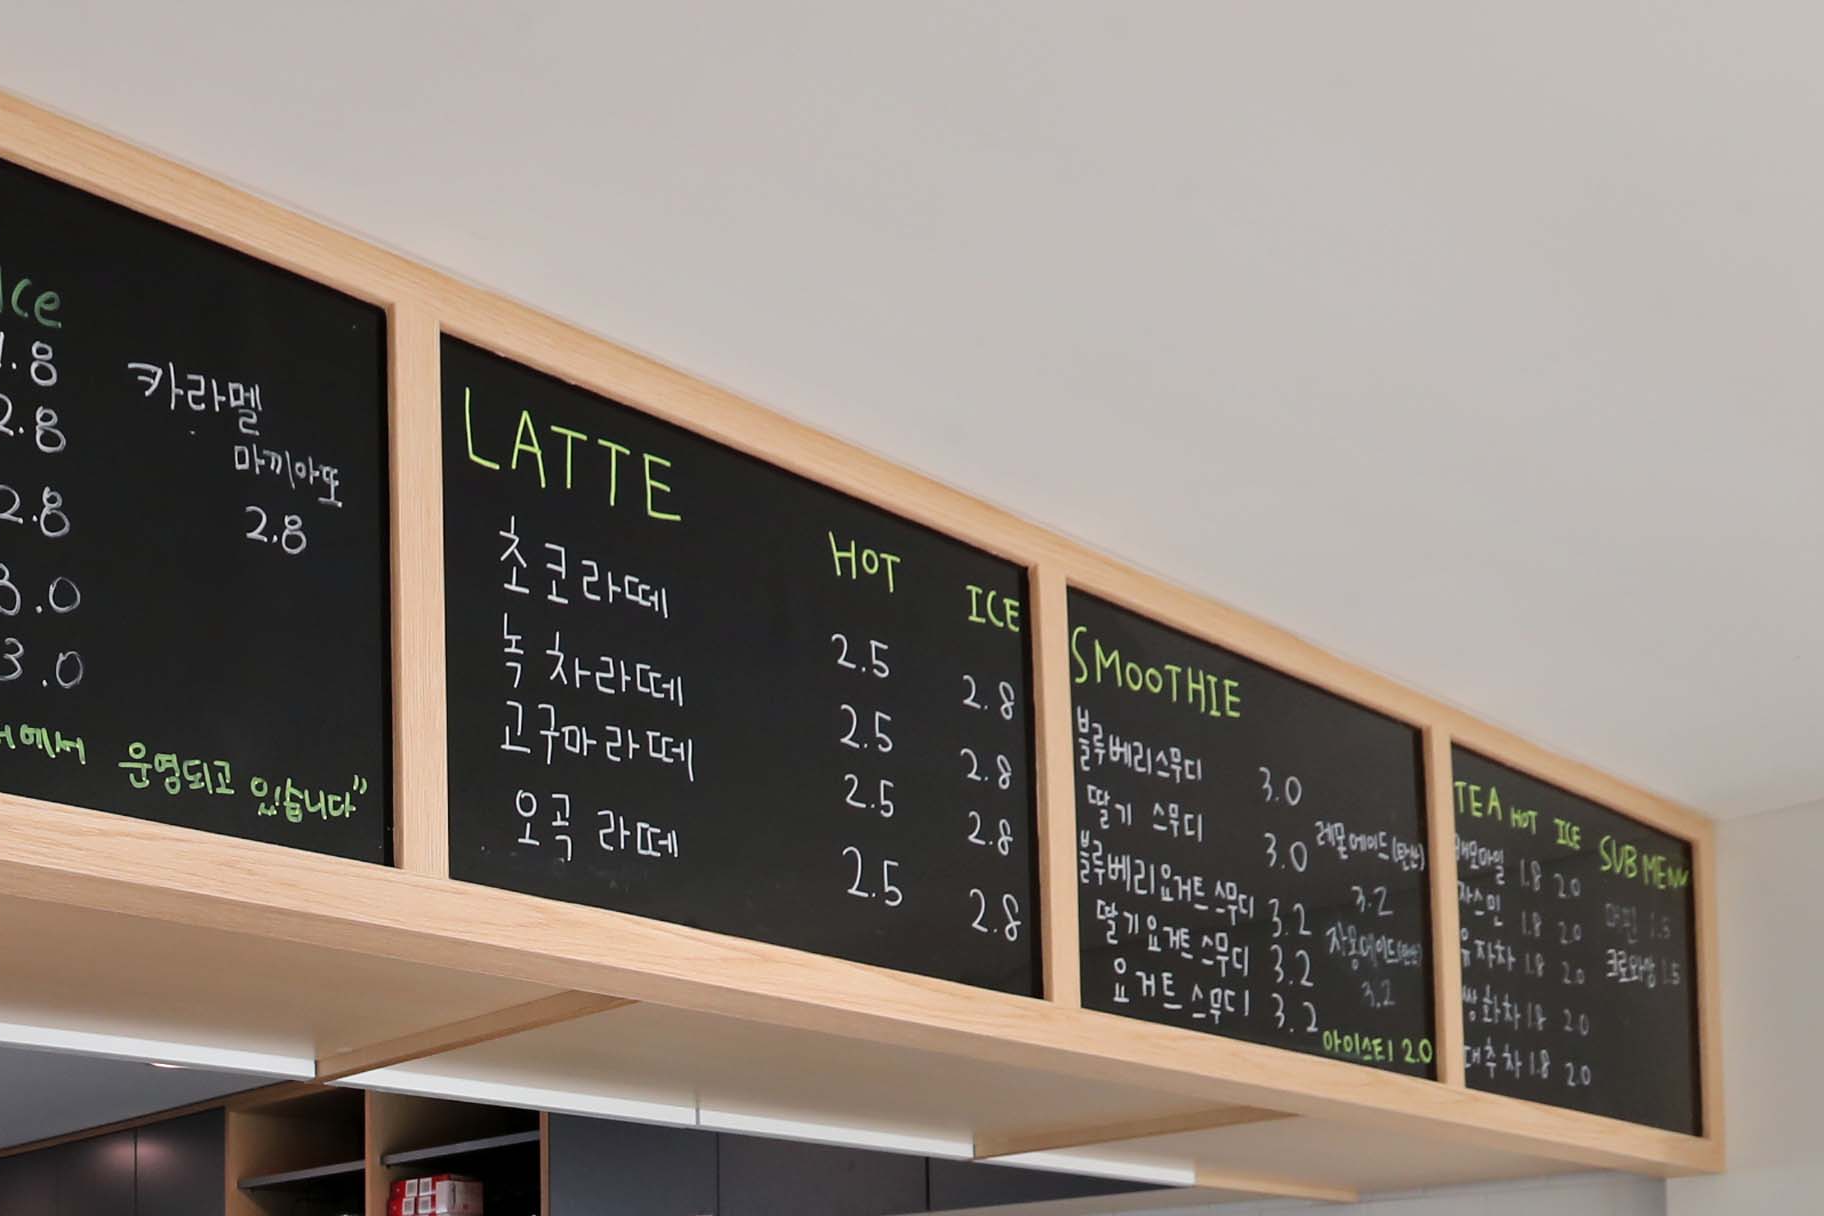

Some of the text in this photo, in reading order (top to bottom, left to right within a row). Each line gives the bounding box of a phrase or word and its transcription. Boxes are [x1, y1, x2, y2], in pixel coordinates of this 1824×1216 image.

[127, 362, 262, 434] 카라멜
[465, 386, 681, 521] LATTE
[245, 506, 307, 554] 2.8
[499, 515, 669, 619] 초코라떼
[829, 530, 1020, 632] HOT ICE
[504, 612, 683, 707] 녹차라떼
[831, 634, 1015, 720] 2.5 2.8
[1071, 626, 1241, 718] SMOOTHIE
[118, 742, 235, 795] 운영되고
[500, 701, 694, 782] 고구마라떼
[840, 704, 1012, 790] 2.5 2.8
[844, 773, 1013, 856] 2.5 2.8
[1259, 766, 1302, 806] 3.0
[1454, 781, 1582, 850] TEA HOT ICE
[1264, 832, 1308, 873] 3.0
[1599, 834, 1637, 879] SUB
[842, 846, 1021, 942] 2.5 2.8
[1268, 898, 1312, 938] 3.2
[1351, 886, 1393, 916] 3.2
[1270, 944, 1314, 987] 3.2
[1271, 993, 1319, 1033] 3.2
